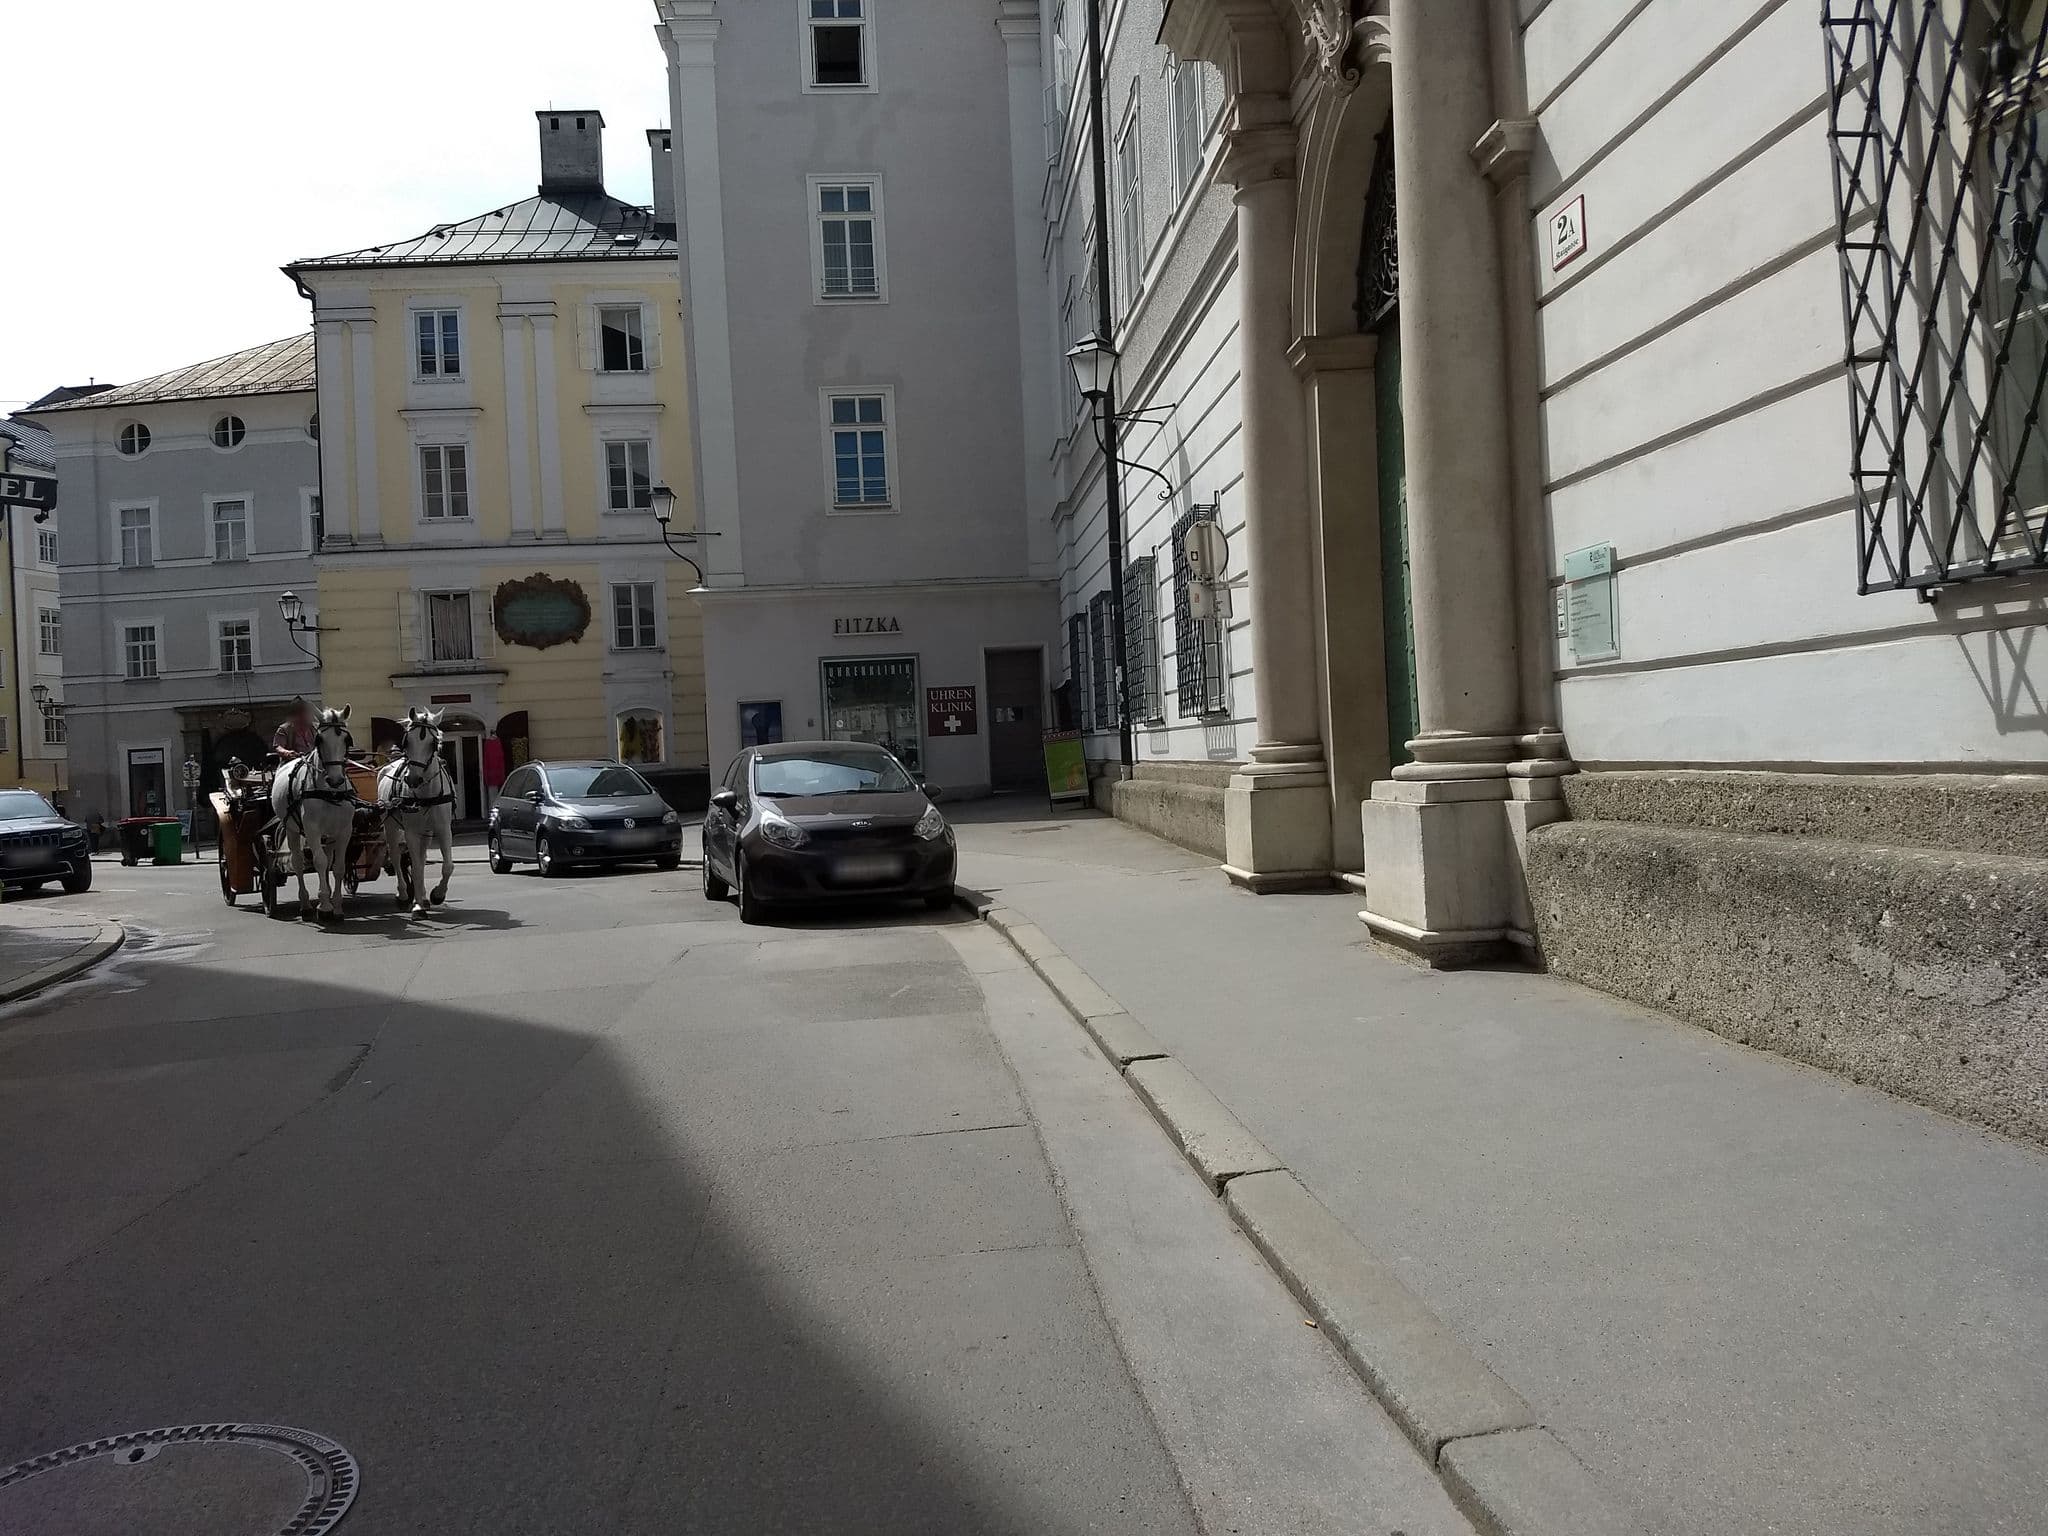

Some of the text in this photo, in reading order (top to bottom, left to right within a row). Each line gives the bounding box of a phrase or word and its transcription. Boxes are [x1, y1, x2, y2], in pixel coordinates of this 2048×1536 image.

[834, 617, 900, 633] FITZKA
[930, 689, 973, 702] UHREN
[931, 701, 974, 713] KLINIK
